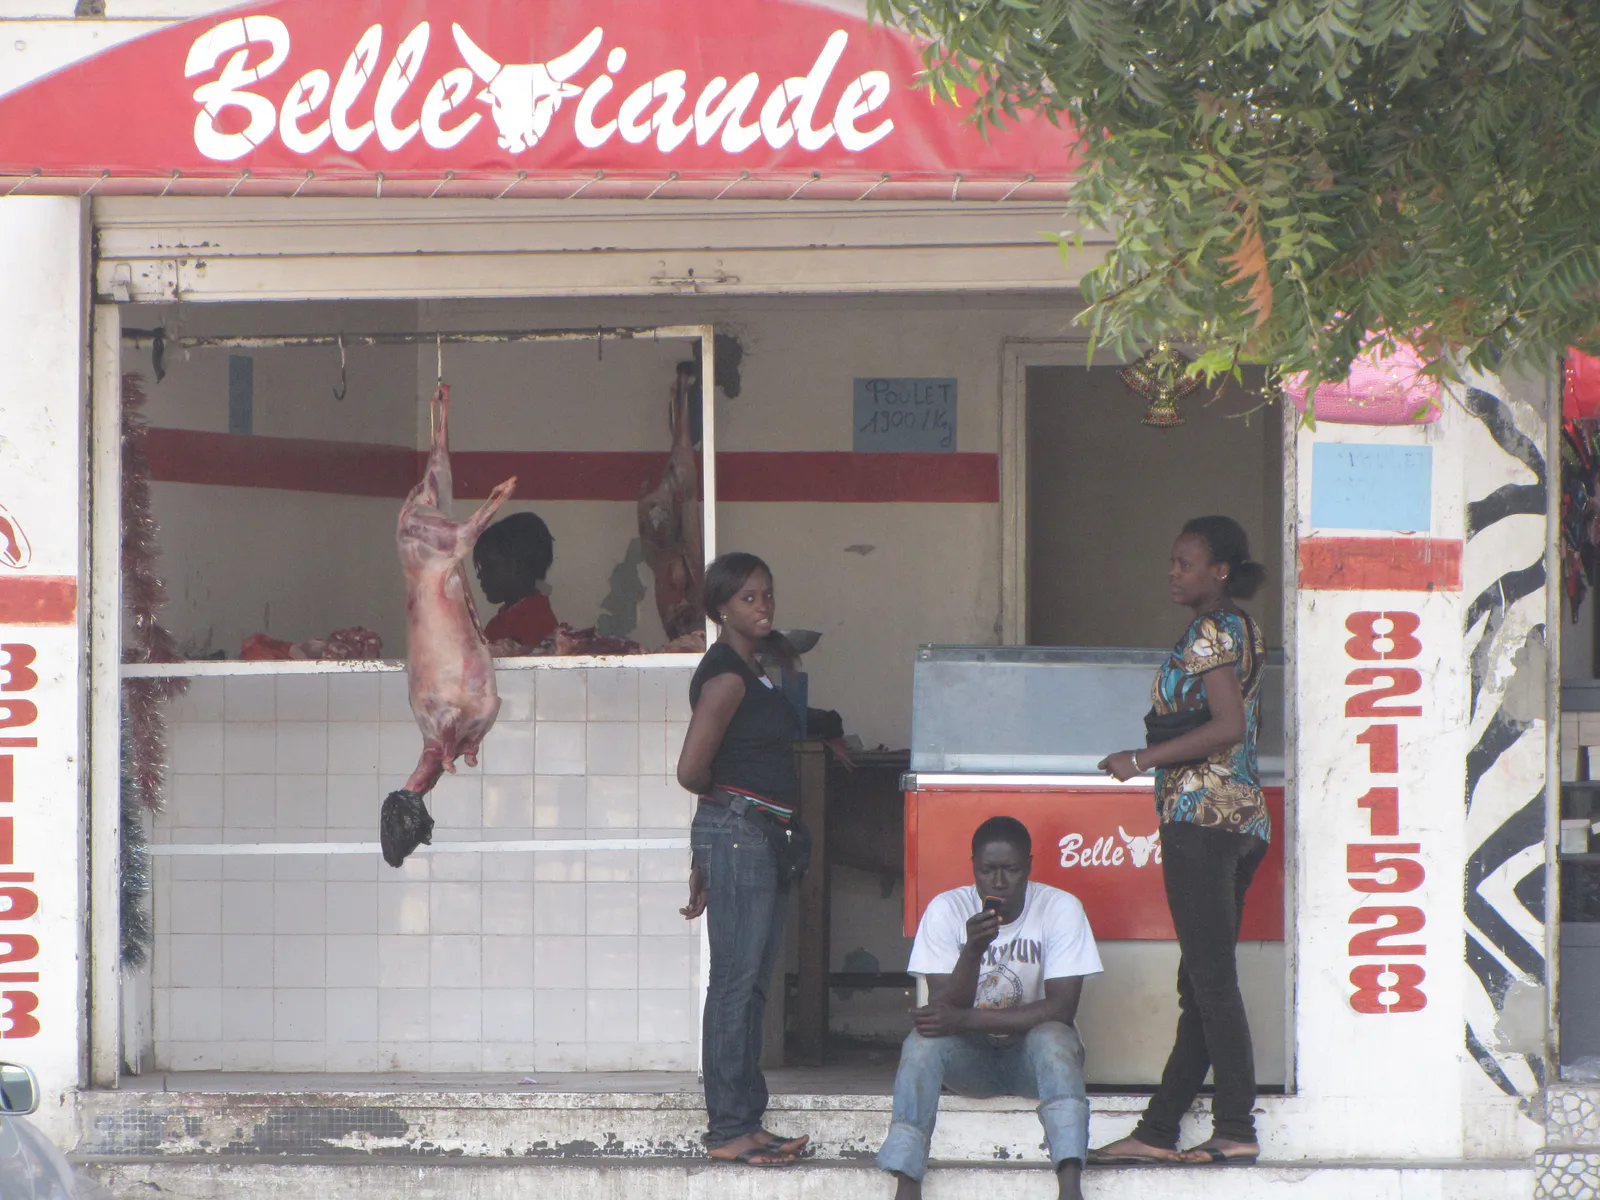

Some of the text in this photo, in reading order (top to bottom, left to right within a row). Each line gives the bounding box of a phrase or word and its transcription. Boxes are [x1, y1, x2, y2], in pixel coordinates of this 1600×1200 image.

[184, 15, 483, 161] Belle
[1058, 832, 1124, 868] Belle
[1344, 610, 1428, 1015] 8211528
